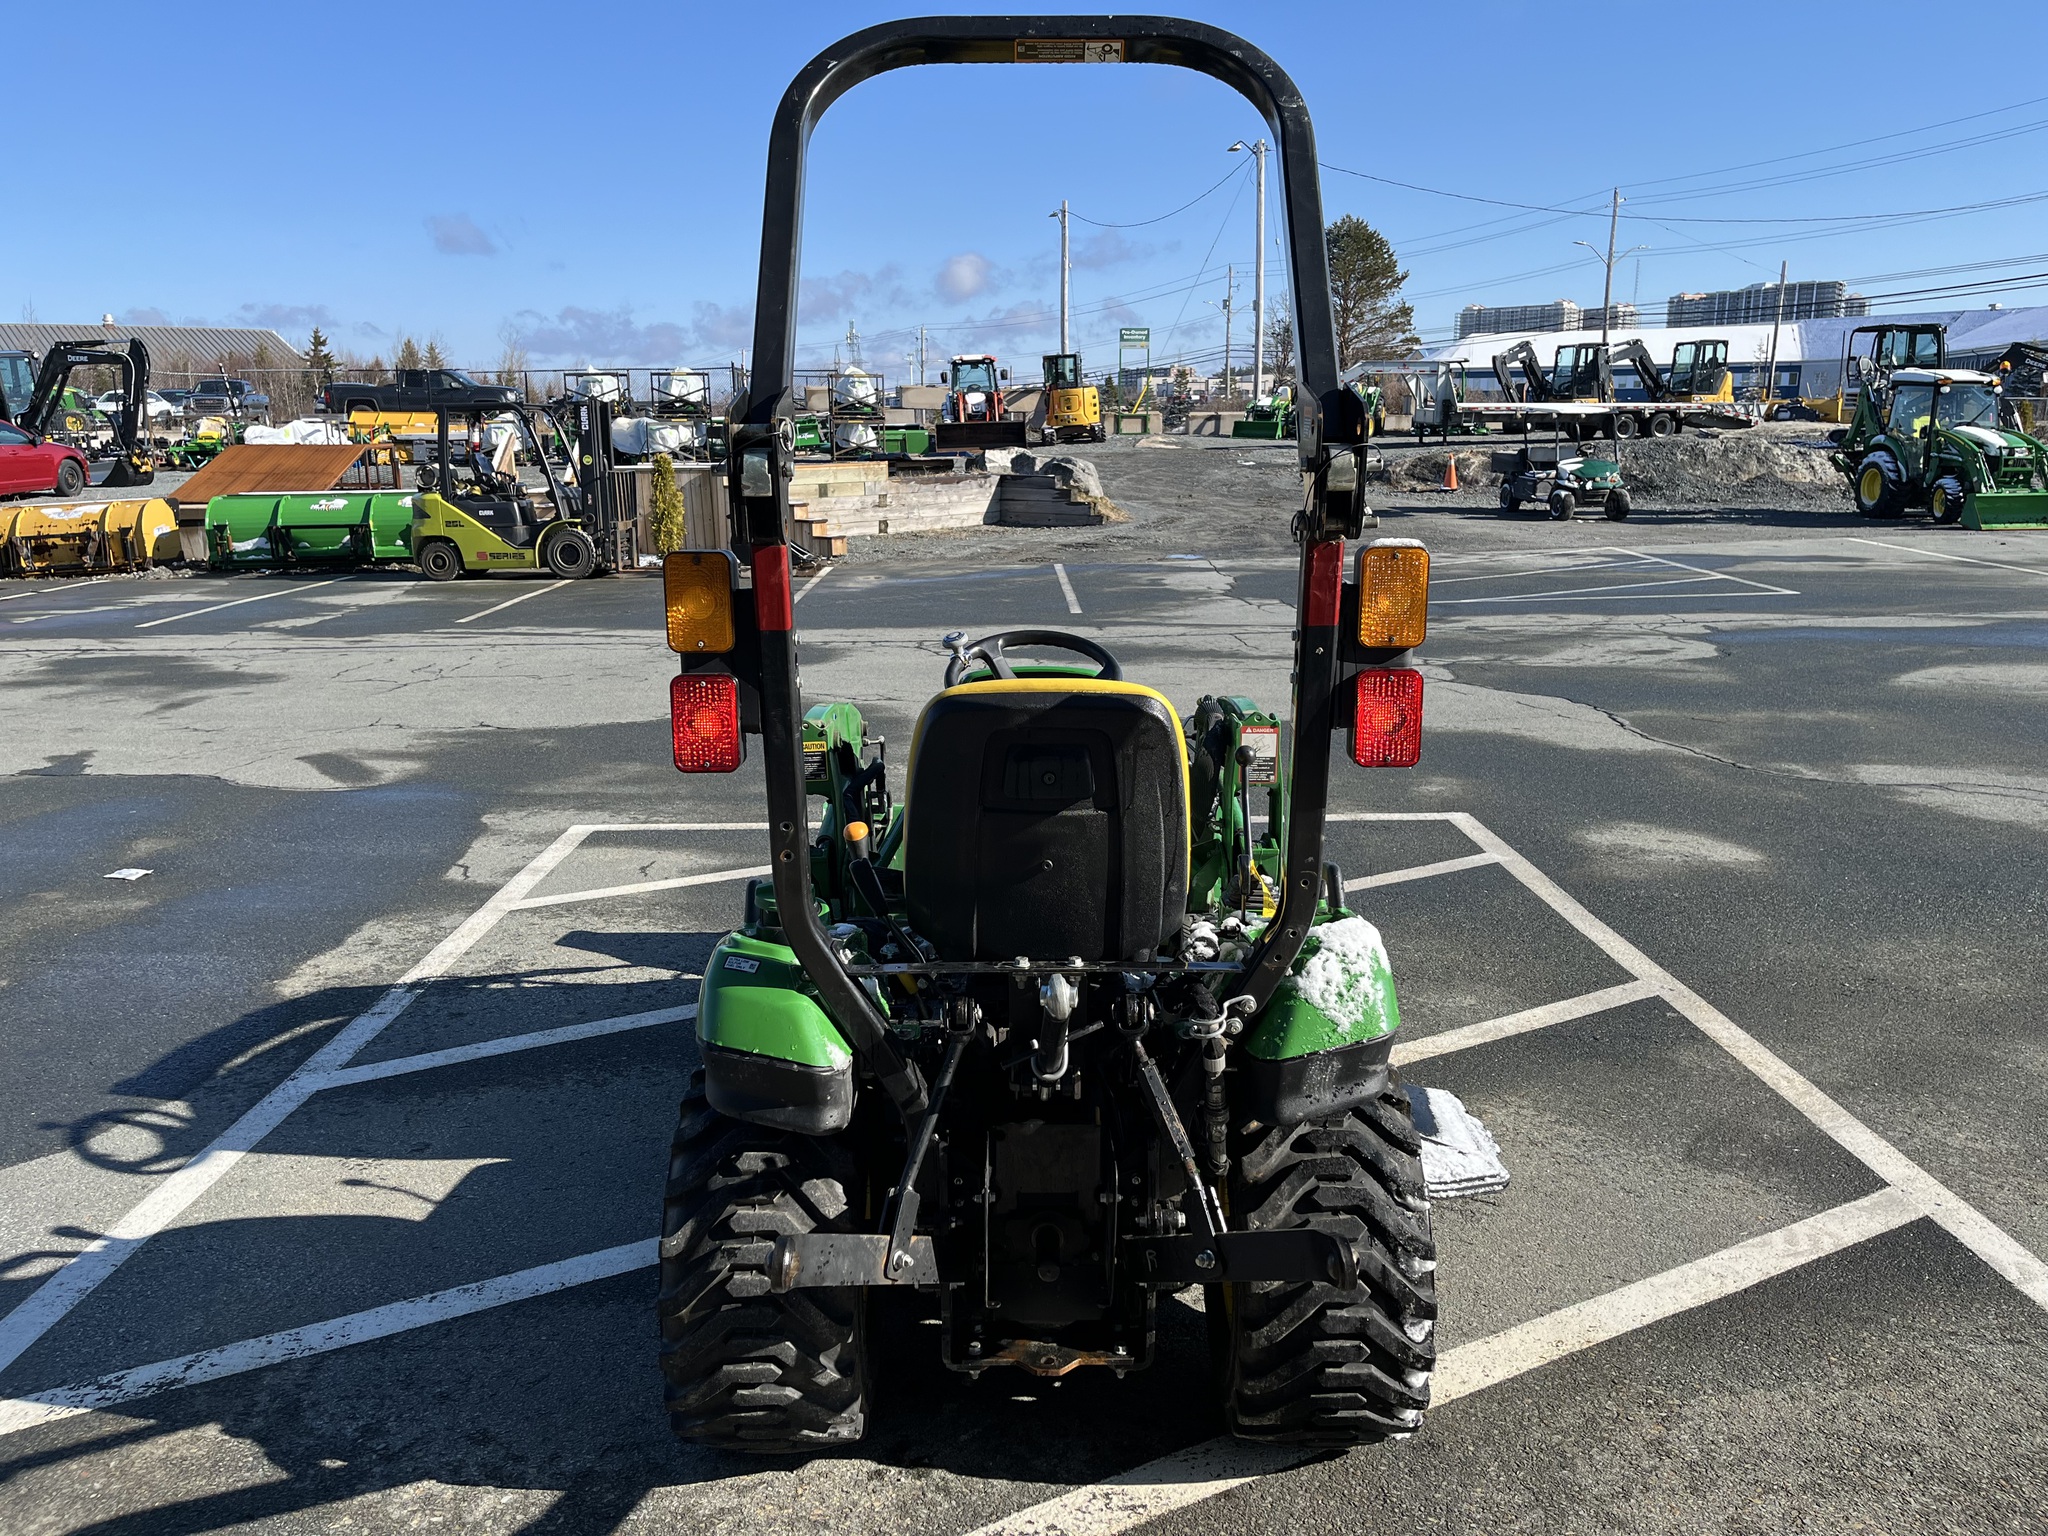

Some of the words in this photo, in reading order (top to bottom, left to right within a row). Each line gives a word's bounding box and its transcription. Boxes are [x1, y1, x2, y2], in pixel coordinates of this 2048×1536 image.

[67, 354, 89, 362] DEERE
[2025, 358, 2047, 369] DEERE
[580, 405, 589, 431] CLARK
[489, 552, 526, 560] SERIES
[1145, 1248, 1158, 1273] R
